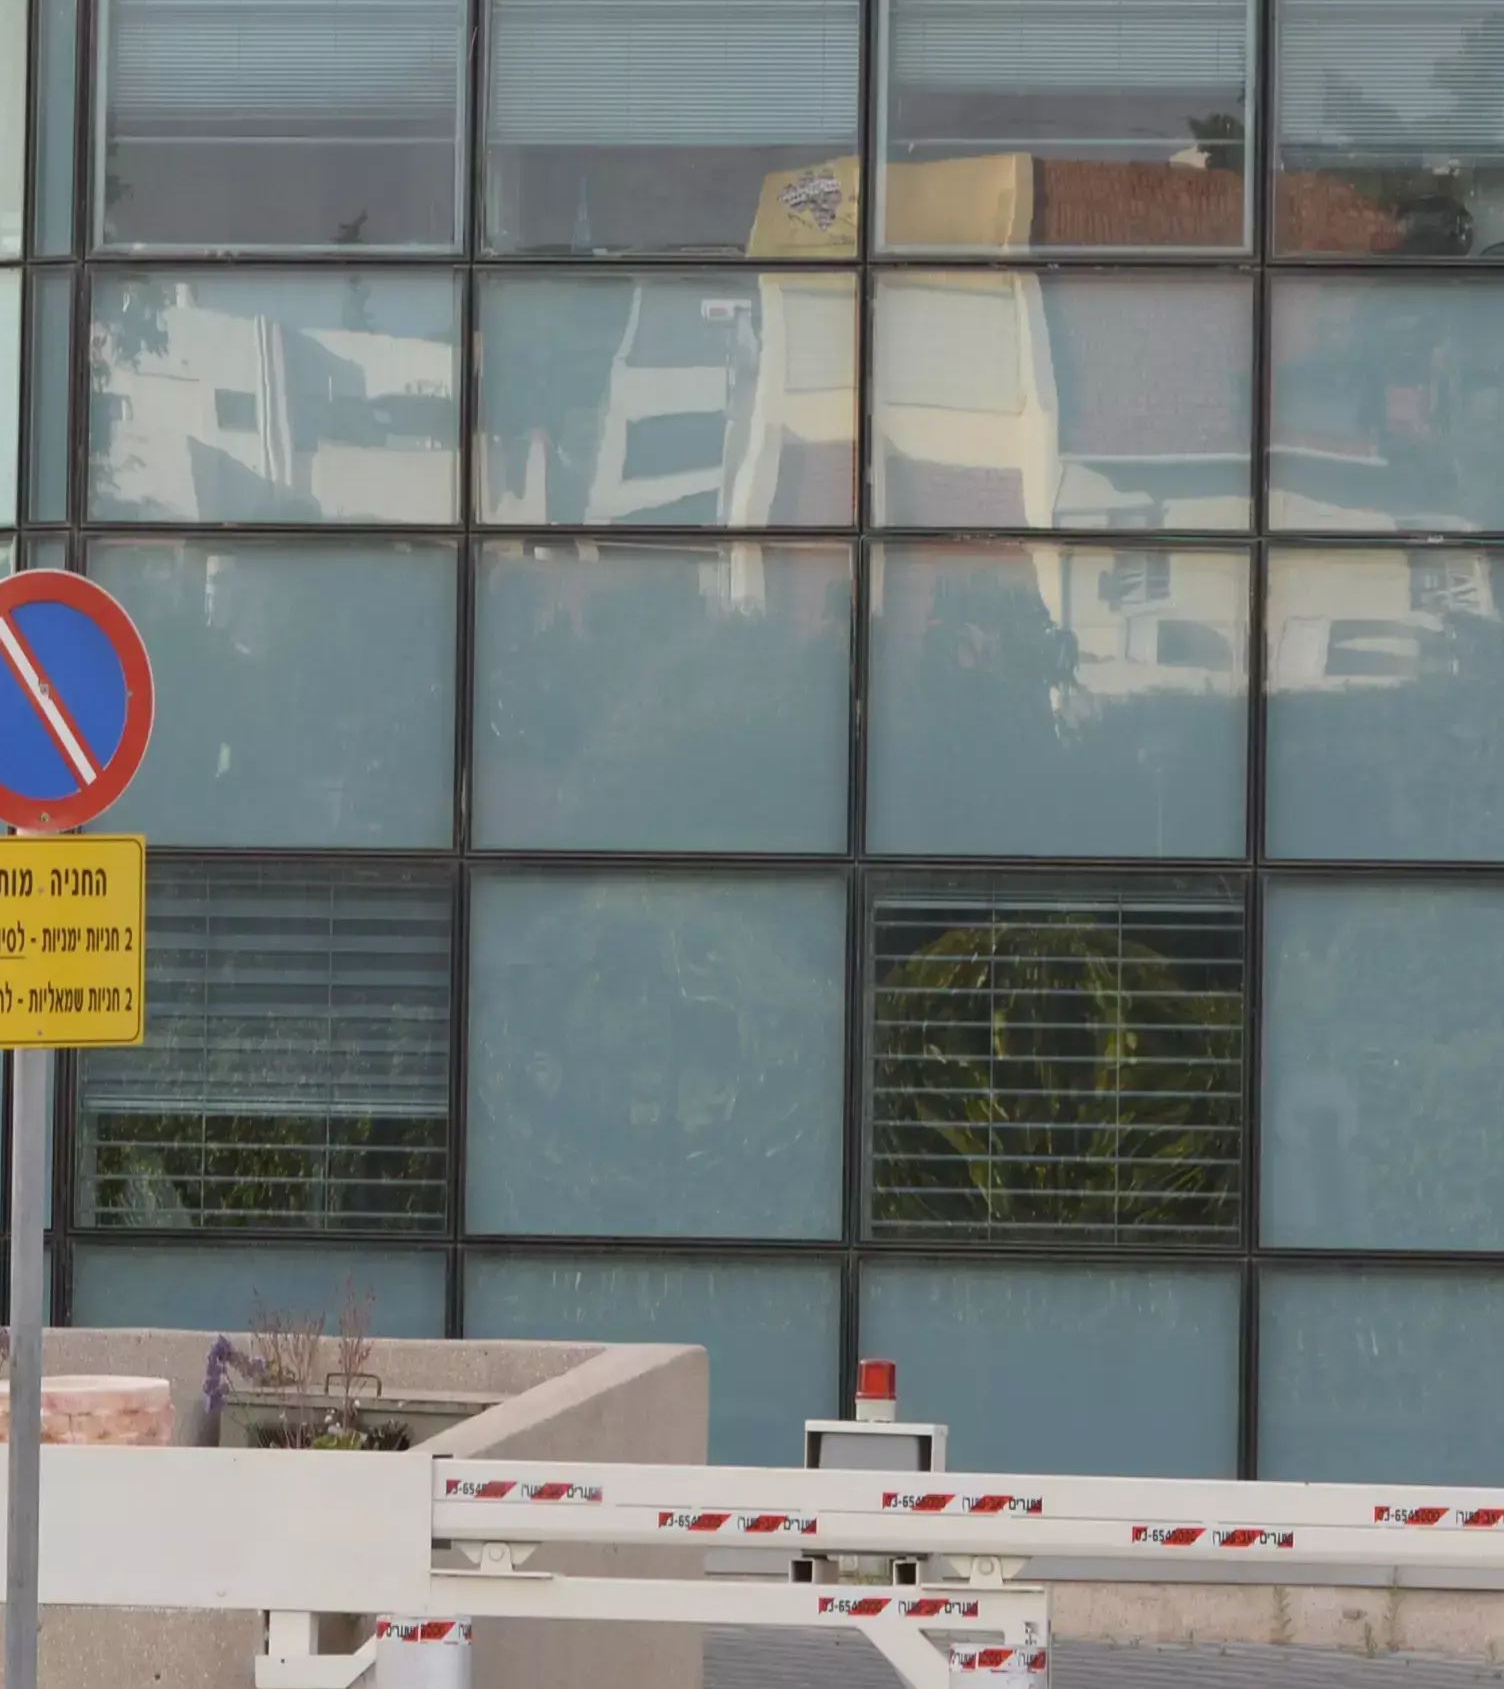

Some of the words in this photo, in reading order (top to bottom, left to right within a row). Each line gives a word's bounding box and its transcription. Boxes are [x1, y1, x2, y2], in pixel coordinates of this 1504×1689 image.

[50, 868, 107, 897] החניה
[41, 927, 81, 953] ימניות
[86, 927, 120, 952] חניות
[124, 927, 133, 951] 2
[28, 981, 84, 1013] שמאליות
[88, 987, 120, 1013] חניות
[124, 987, 133, 1012] 2
